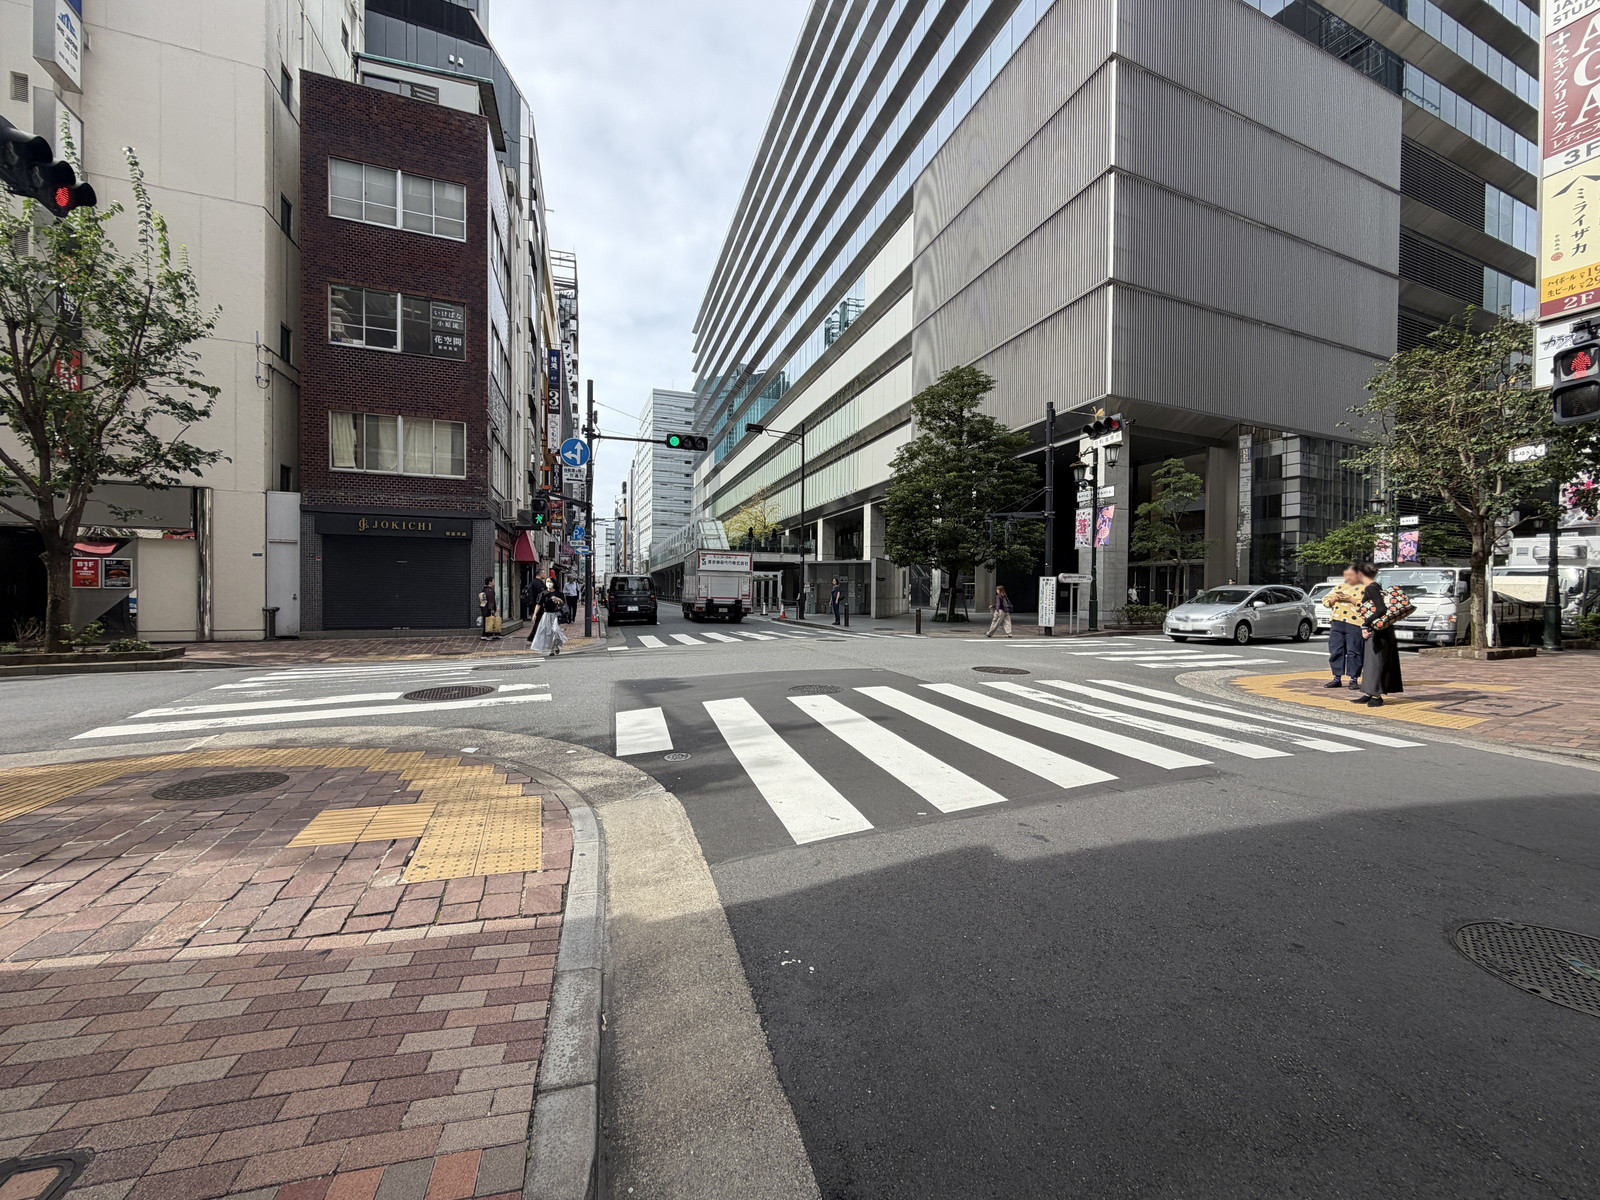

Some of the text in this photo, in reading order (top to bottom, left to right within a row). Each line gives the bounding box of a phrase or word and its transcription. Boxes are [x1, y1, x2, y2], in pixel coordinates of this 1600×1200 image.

[1570, 187, 1591, 258] ミライザカ
[1563, 291, 1595, 310] 2F
[434, 335, 462, 347] 花空間
[372, 520, 432, 531] JOKICHI
